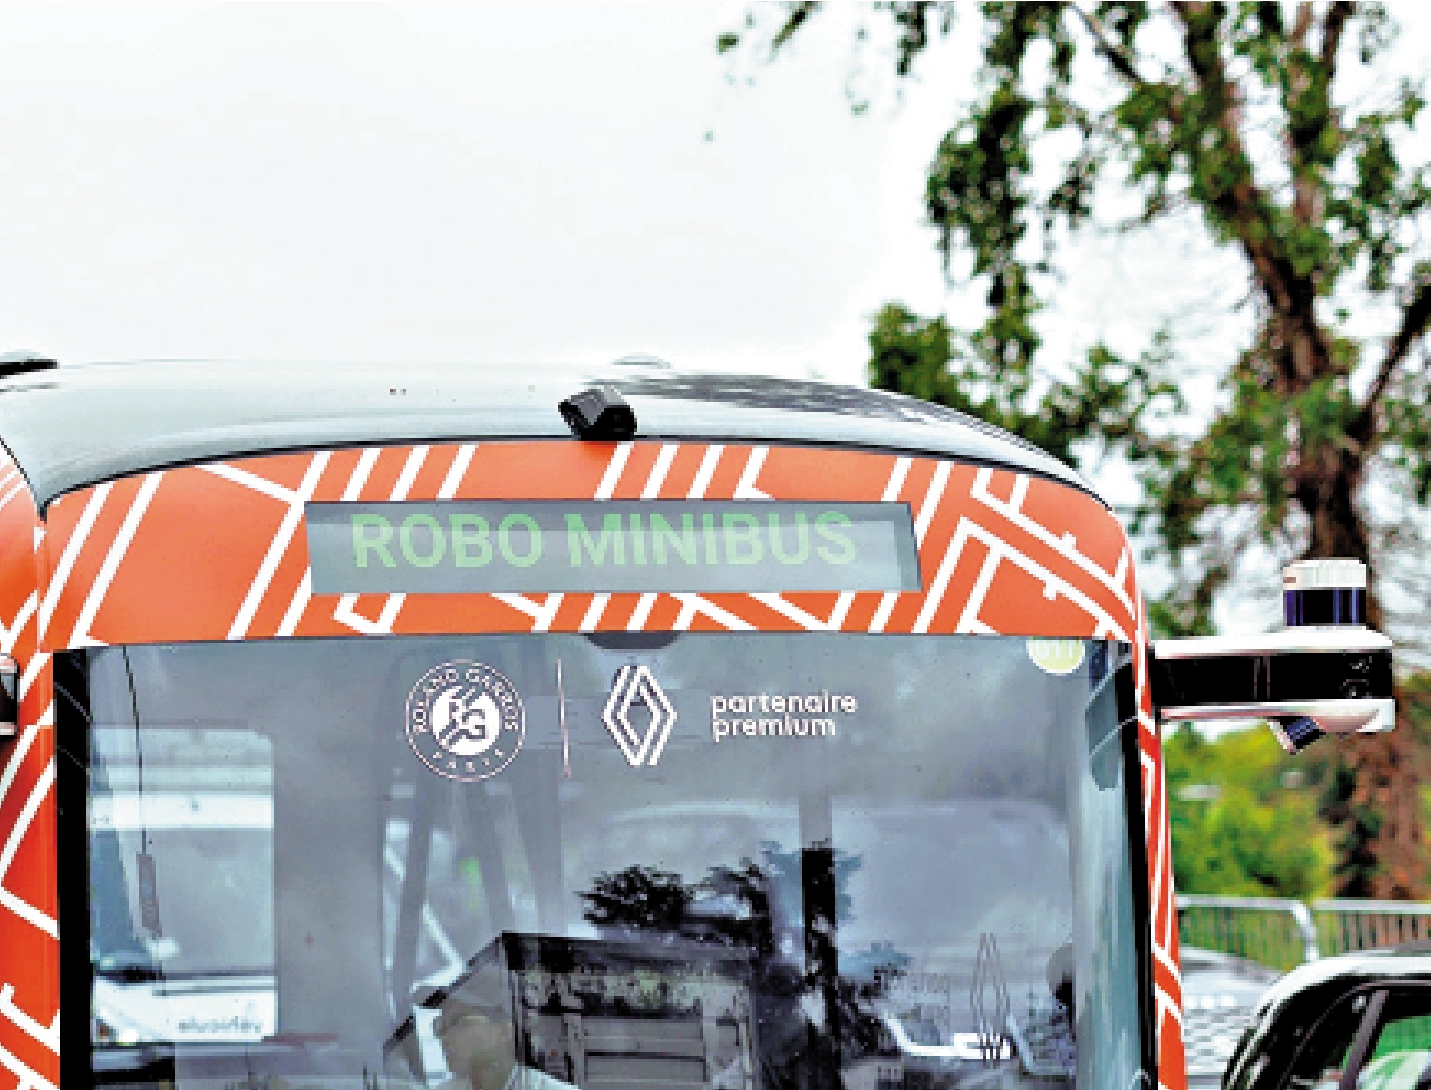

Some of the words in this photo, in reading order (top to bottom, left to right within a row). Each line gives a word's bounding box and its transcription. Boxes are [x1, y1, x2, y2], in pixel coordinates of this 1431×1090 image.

[350, 513, 544, 570] ROBO
[569, 511, 857, 569] MINIBUS
[709, 688, 859, 720] partenaire
[711, 712, 836, 743] premium
